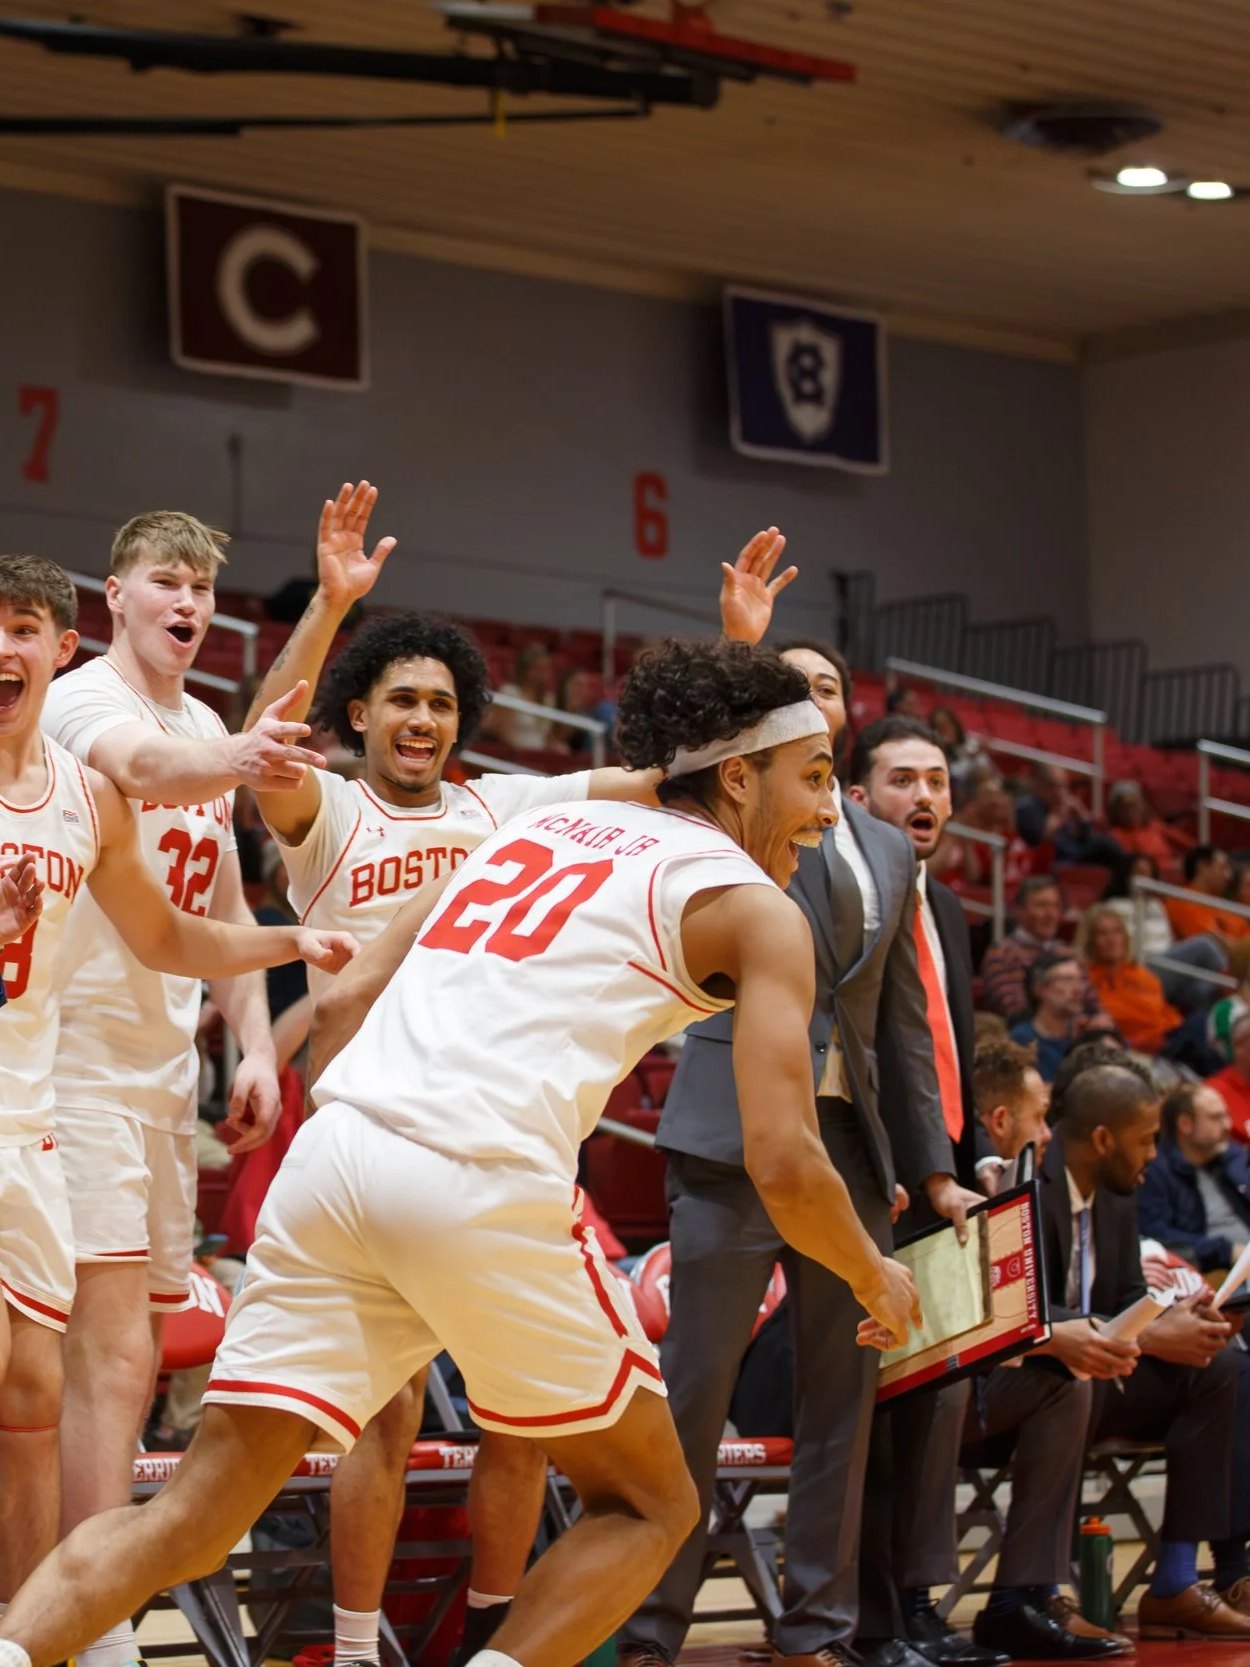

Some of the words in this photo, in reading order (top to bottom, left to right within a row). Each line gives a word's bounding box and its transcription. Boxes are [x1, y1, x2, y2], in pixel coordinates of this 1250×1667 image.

[219, 226, 320, 355] C
[19, 385, 59, 484] 7
[633, 471, 669, 560] 6
[158, 827, 220, 918] 32
[350, 846, 474, 907] BOSTO
[418, 838, 614, 962] 20
